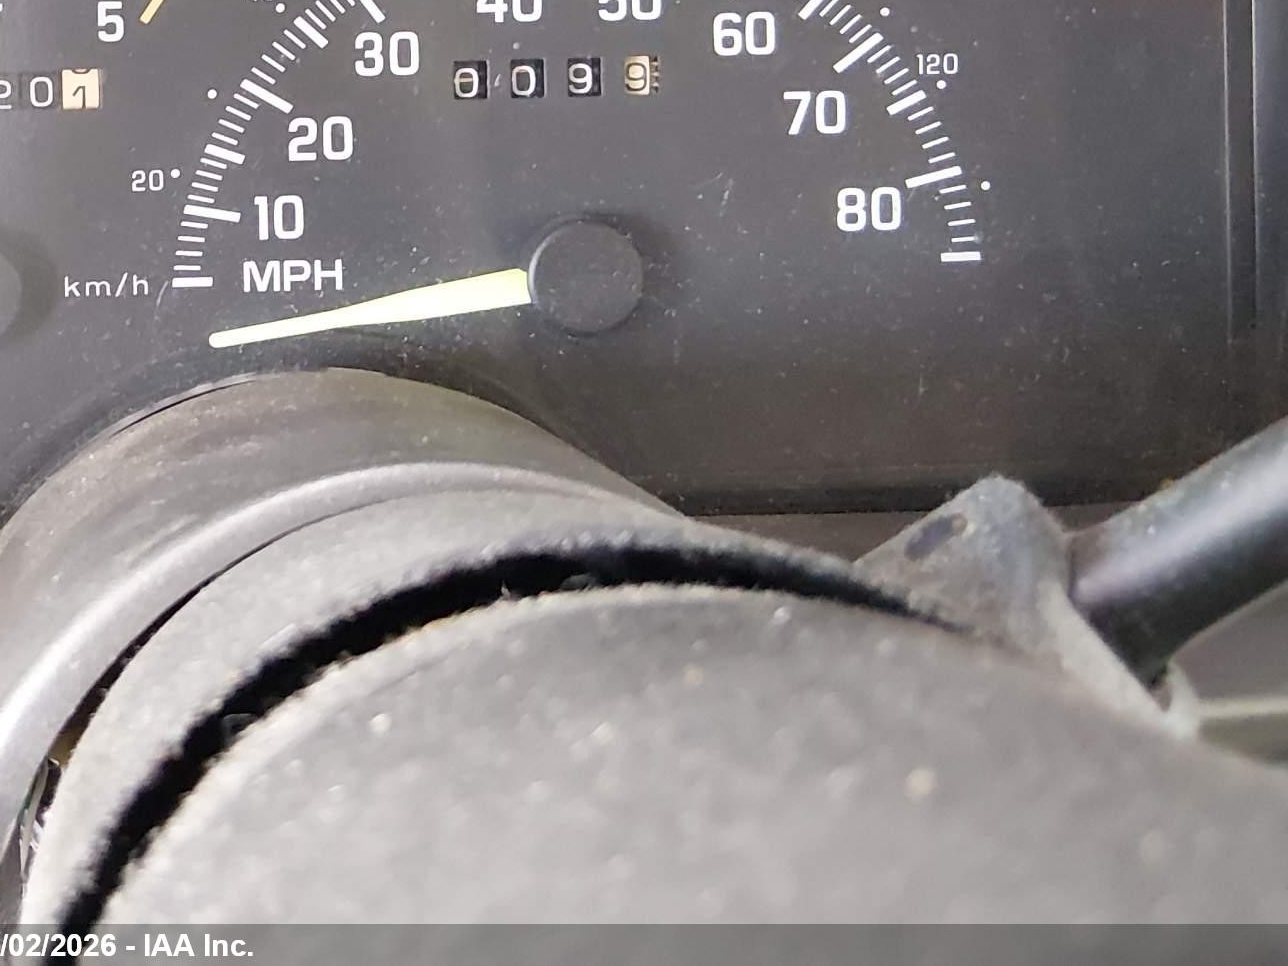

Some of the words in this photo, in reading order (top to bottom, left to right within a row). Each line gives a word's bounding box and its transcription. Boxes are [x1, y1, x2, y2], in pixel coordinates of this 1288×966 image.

[97, 0, 125, 43] 5
[713, 11, 776, 57] 60
[354, 31, 420, 77] 30
[916, 53, 960, 75] 120
[783, 90, 848, 135] 70
[288, 115, 354, 162] 20
[131, 169, 165, 192] 20
[253, 194, 305, 241] 10
[836, 186, 902, 232] 80
[64, 272, 149, 298] km/h
[242, 258, 344, 293] MPH
